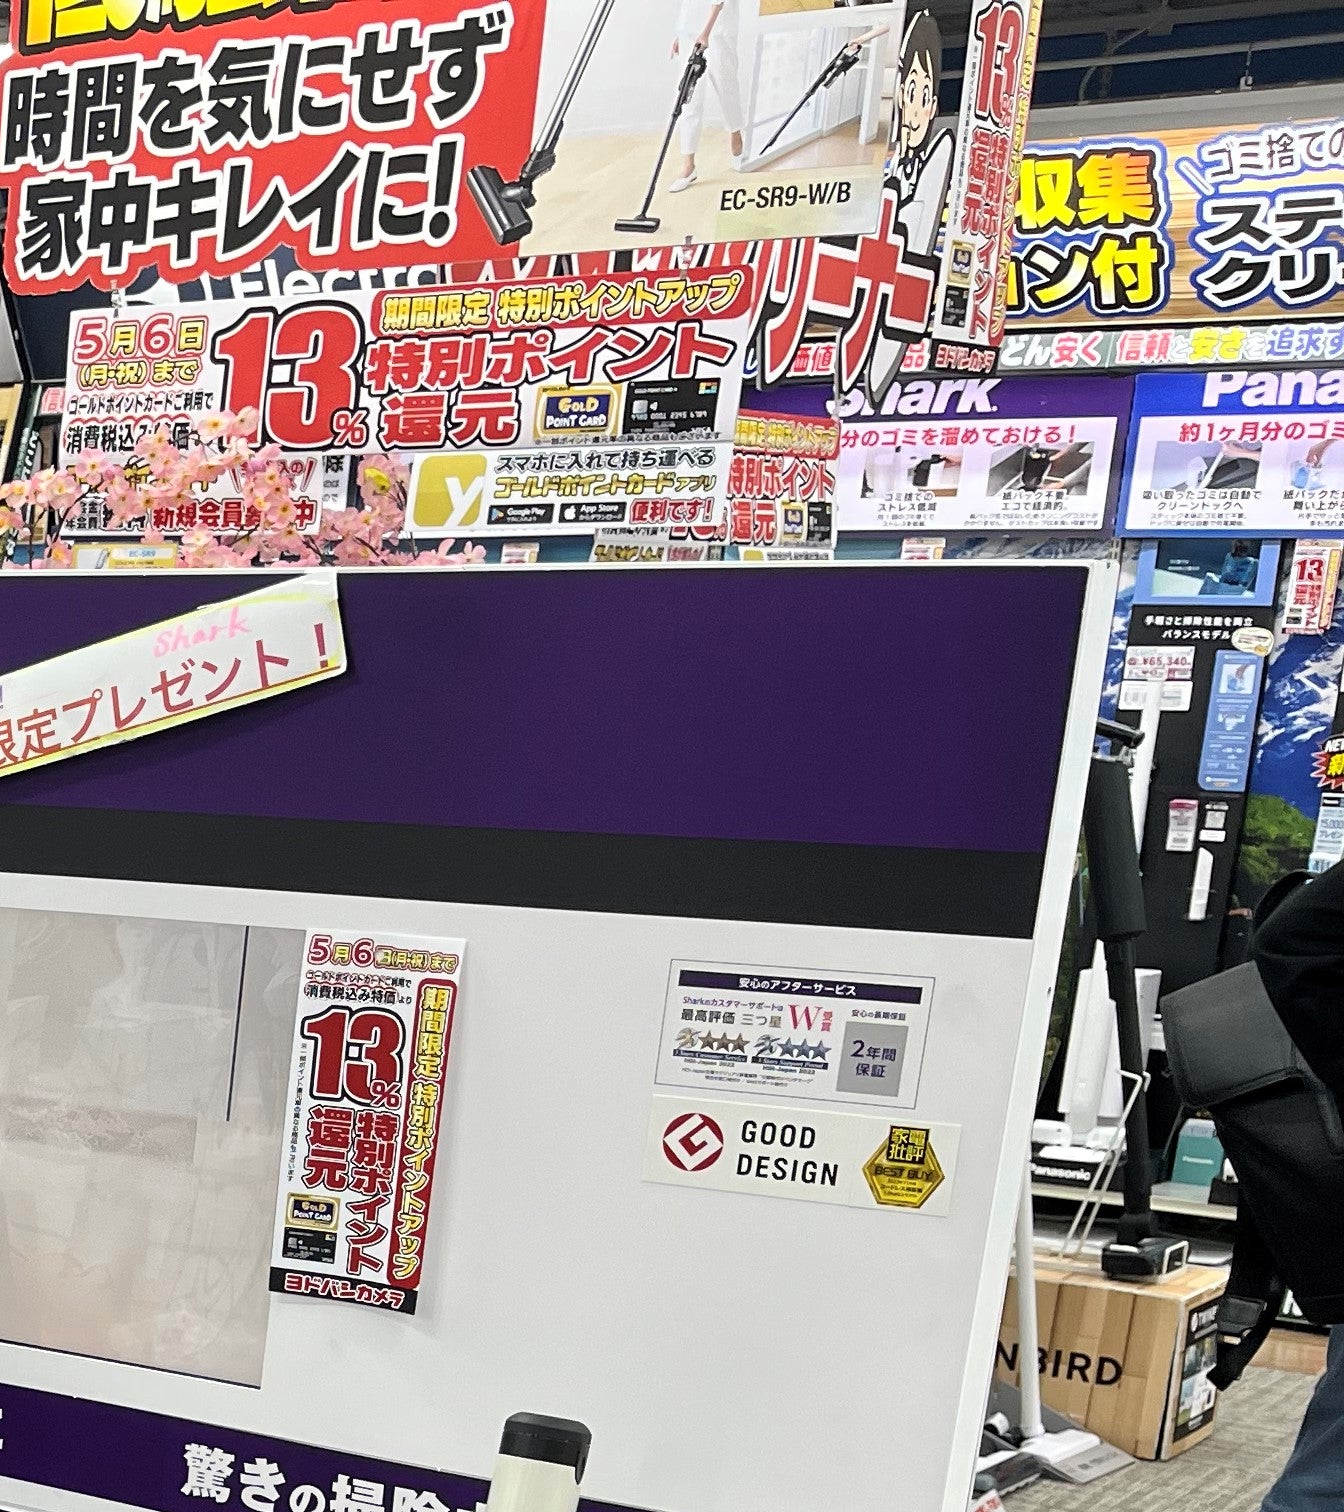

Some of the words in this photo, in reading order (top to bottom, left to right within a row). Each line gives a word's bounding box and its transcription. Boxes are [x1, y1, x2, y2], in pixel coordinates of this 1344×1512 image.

[4, 14, 508, 168] 時間を気にせず
[17, 140, 462, 276] 家中キレイに!
[720, 182, 853, 212] EC-SR9-W/B
[382, 291, 488, 332] 期間限定
[497, 272, 742, 325] 特別ポイントアップ
[365, 323, 740, 391] 特別ポイント
[382, 393, 521, 448] 還元
[495, 447, 715, 473] スマホに入れて持ち運べる
[494, 472, 676, 498] ゴールドポイントカード
[153, 605, 252, 659] Shark
[737, 976, 858, 997] 安心のアフターサービス
[414, 985, 448, 1081] 期間限定
[680, 1008, 736, 1026] 最高評価
[851, 1038, 897, 1063] 2年間
[854, 1063, 886, 1079] 保証
[302, 1105, 354, 1192] 還元
[740, 1119, 817, 1150] GOOD
[345, 1109, 402, 1275] 特別ポイント
[392, 1082, 440, 1280] 特別ポイントアップ
[736, 1153, 840, 1187] DESIGN
[284, 1273, 406, 1309] ヨドバシカメラ
